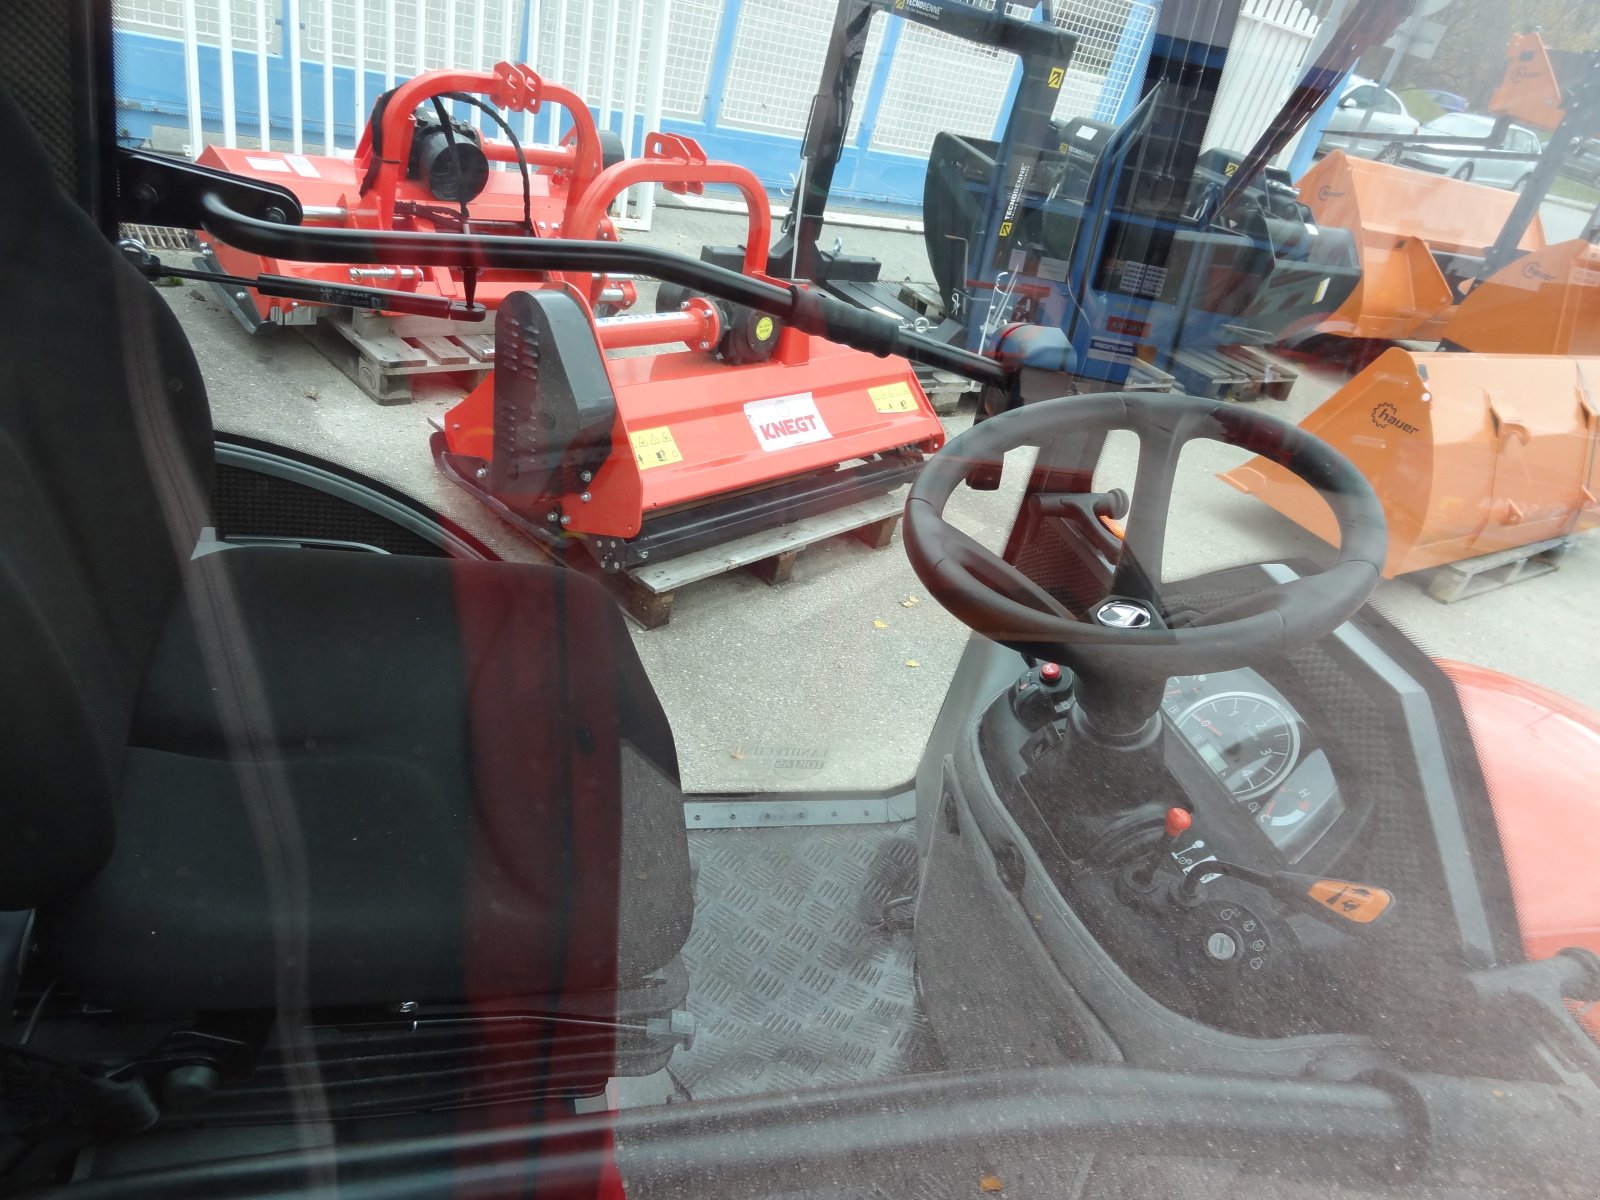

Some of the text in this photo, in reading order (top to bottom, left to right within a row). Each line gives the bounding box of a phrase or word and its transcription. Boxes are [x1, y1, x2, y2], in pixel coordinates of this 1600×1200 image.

[1004, 164, 1027, 221] TECNOBENNE
[1378, 408, 1420, 434] hauer
[759, 414, 817, 440] KNEGT
[1255, 721, 1268, 731] 2
[1259, 747, 1273, 756] 3
[1242, 769, 1254, 778] 4
[1299, 788, 1311, 798] H
